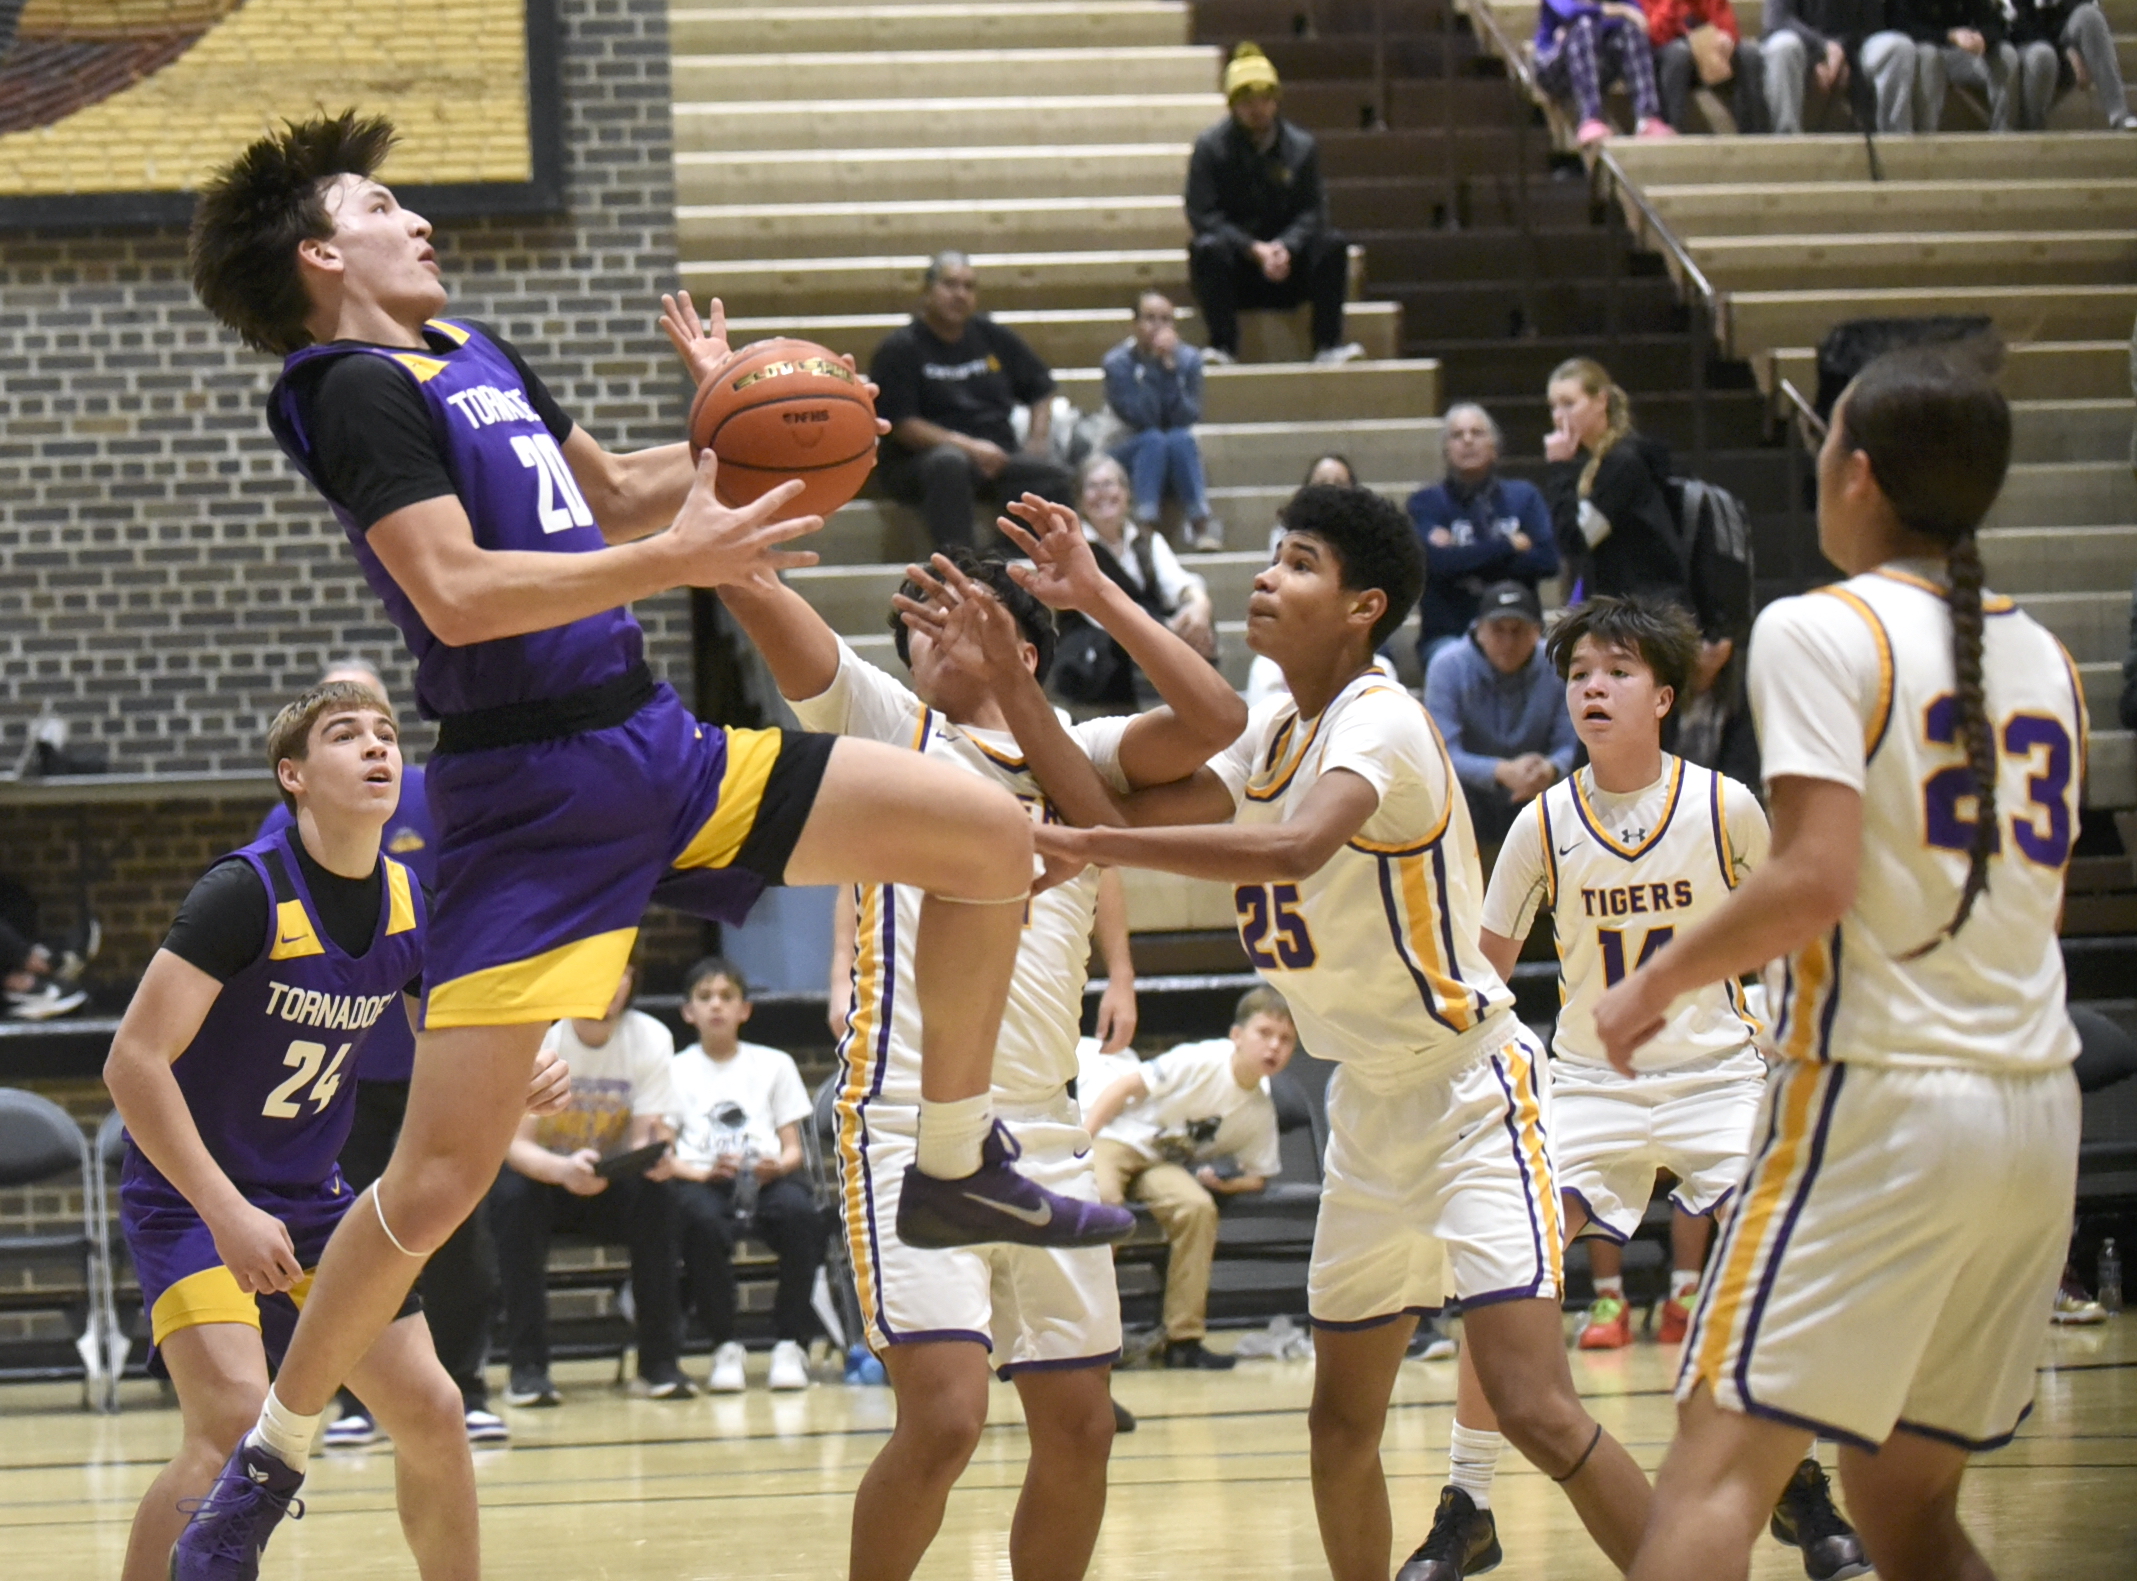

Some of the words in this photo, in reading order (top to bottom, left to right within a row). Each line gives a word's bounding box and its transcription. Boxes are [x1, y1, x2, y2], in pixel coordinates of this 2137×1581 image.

[509, 433, 594, 534] 20
[1922, 689, 2073, 871] 23
[1234, 880, 1319, 972] 25
[1580, 879, 1693, 917] TIGERS
[265, 980, 397, 1030] TORNADOE
[261, 1039, 352, 1119] 24
